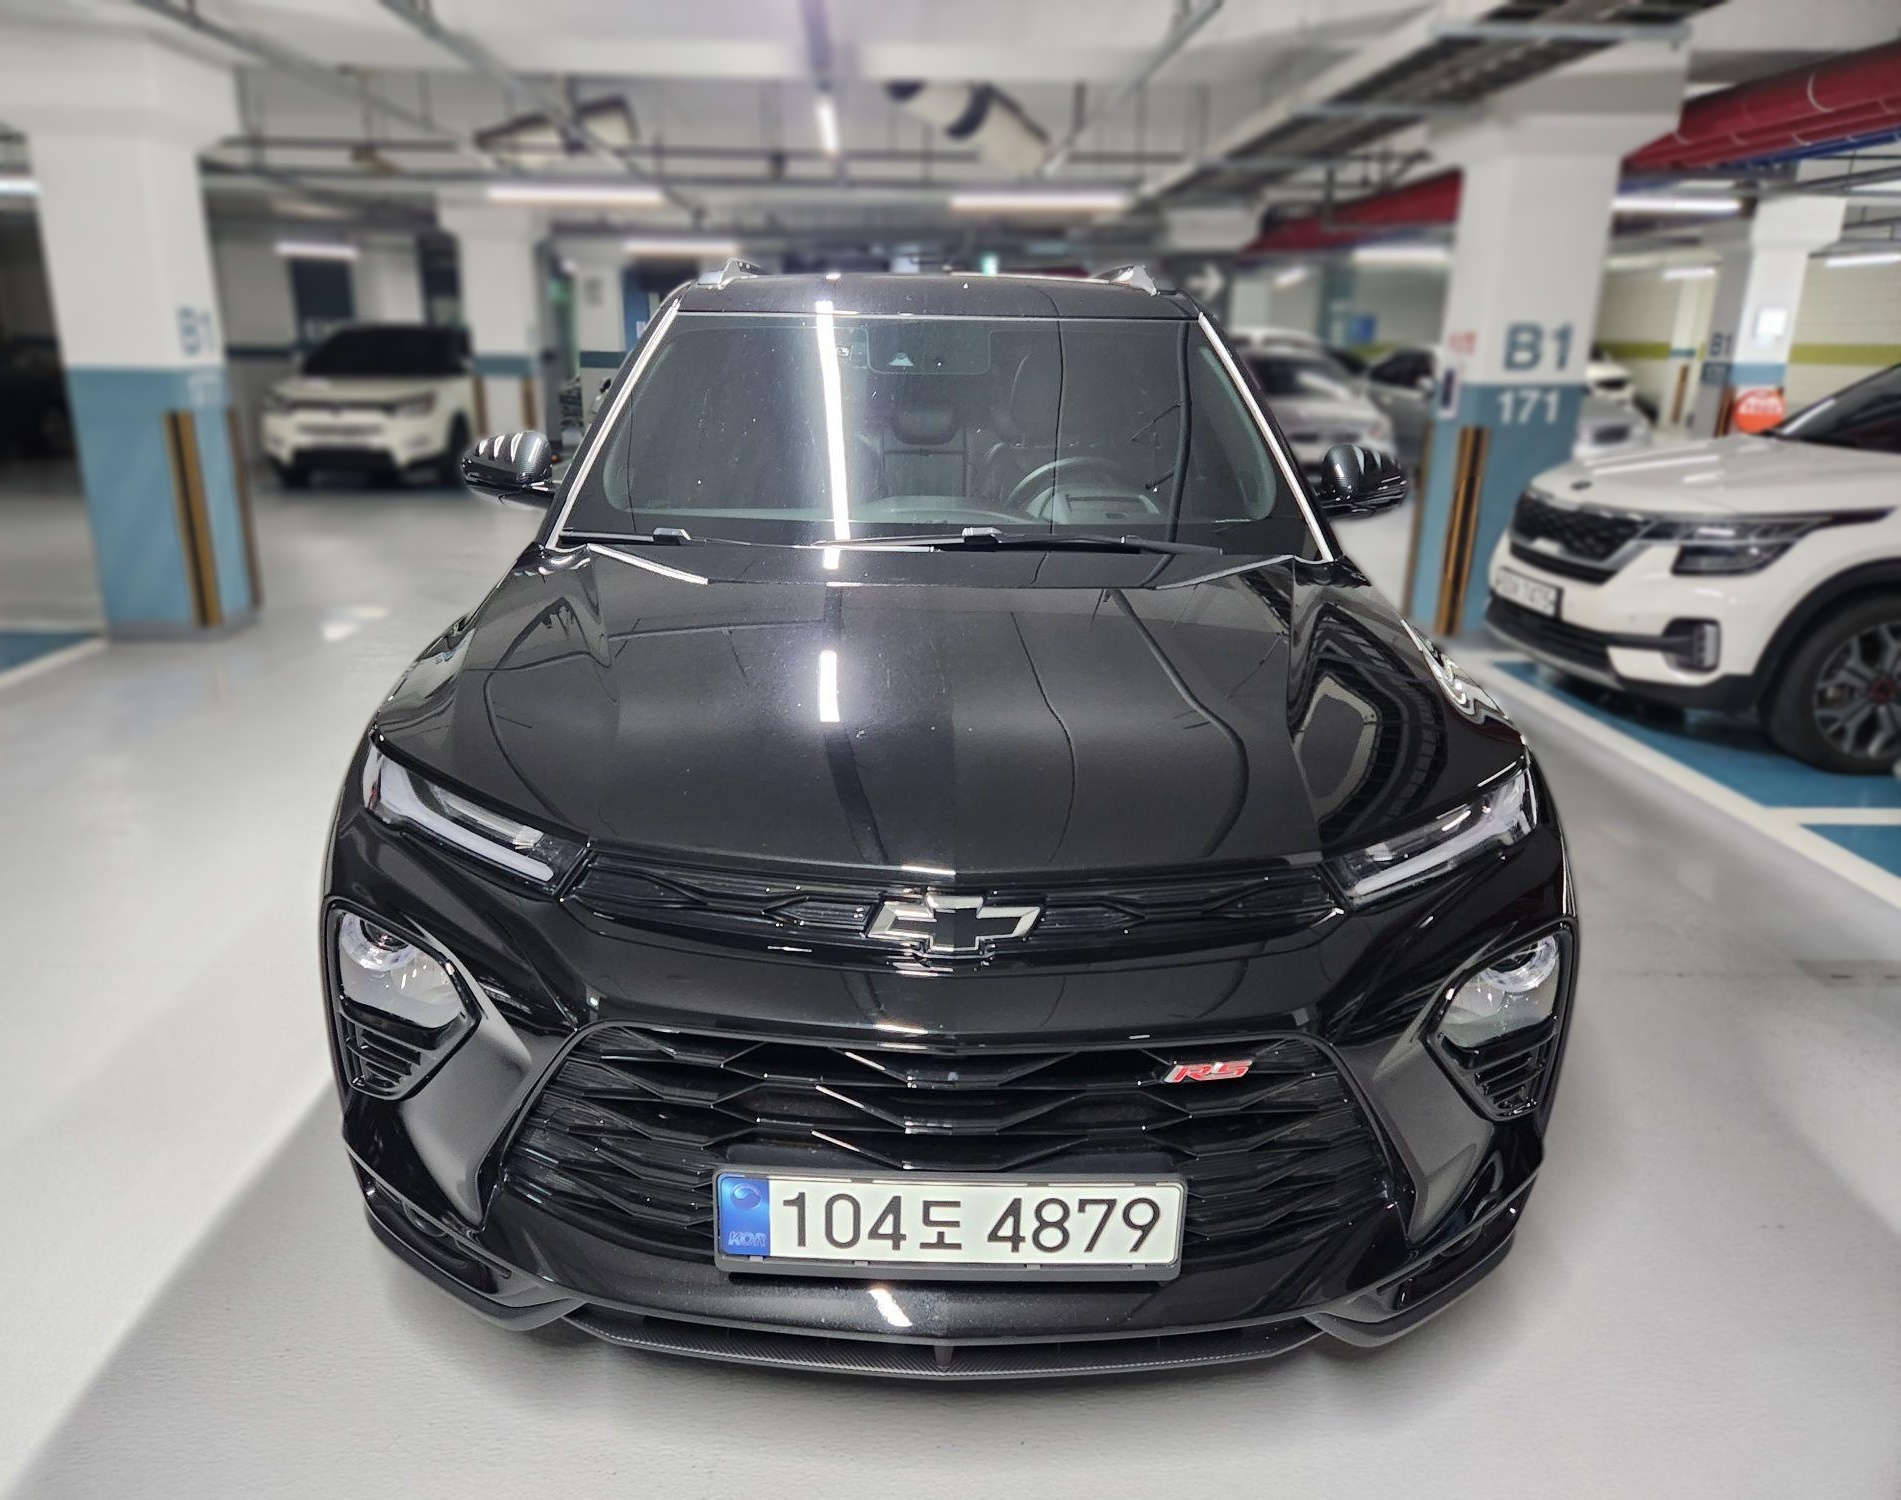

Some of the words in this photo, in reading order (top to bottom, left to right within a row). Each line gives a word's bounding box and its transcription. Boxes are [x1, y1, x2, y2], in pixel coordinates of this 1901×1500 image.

[1503, 322, 1574, 371] B1
[1499, 388, 1560, 424] 171
[1164, 1060, 1253, 1083] RS
[728, 1230, 767, 1248] KOR
[782, 1191, 962, 1251] 104도
[987, 1197, 1161, 1254] 4879
